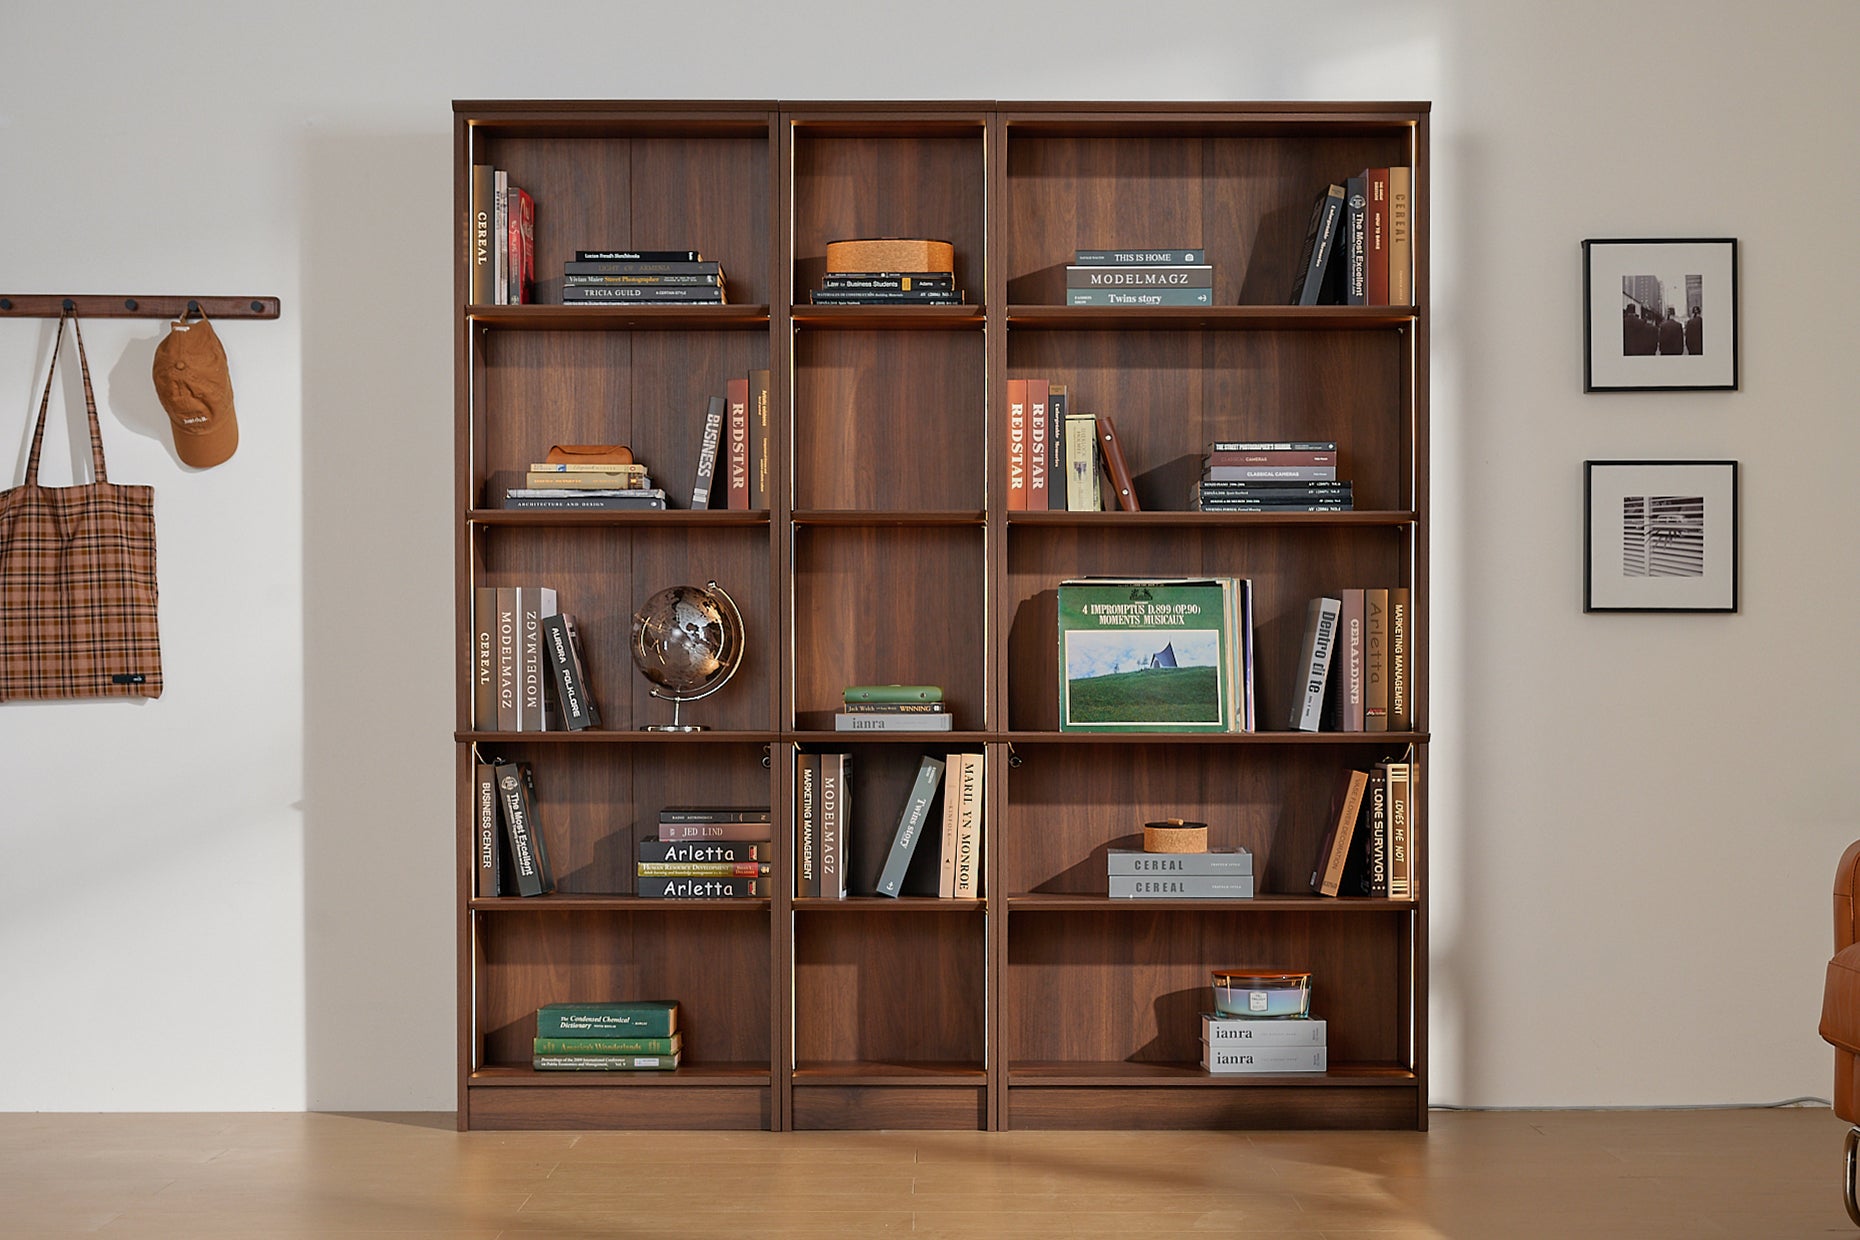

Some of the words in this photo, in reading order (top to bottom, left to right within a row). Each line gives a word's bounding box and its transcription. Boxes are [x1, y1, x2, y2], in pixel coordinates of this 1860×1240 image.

[1355, 212, 1364, 230] The
[1395, 193, 1406, 244] CEREAL
[477, 211, 488, 266] CEREAL
[1355, 231, 1364, 254] Most
[1114, 253, 1134, 262] THIS
[1135, 253, 1144, 262] IS
[1145, 253, 1171, 262] HOME
[622, 276, 660, 284] Photographer
[827, 280, 840, 288] Law
[846, 280, 872, 288] Business
[873, 280, 899, 288] Students
[1090, 273, 1189, 285] MODELMAGZ
[1355, 255, 1364, 297] Excellent
[584, 289, 612, 297] TRICIA
[615, 289, 641, 297] GUILD
[1108, 293, 1137, 304] Twins
[1138, 294, 1162, 304] story
[697, 412, 721, 477] BUSINESS
[731, 402, 745, 489] REDSTAR
[1011, 403, 1023, 489] REDSTAR
[1032, 403, 1045, 489] REDSTAR
[1082, 604, 1088, 615] 4
[1091, 604, 1145, 615] IMPROMPTUS
[1172, 604, 1201, 615] (OP.90)
[1099, 615, 1141, 625] MOMENTS
[1143, 615, 1185, 625] MUSICAUX
[1314, 610, 1336, 659] Dentro
[1394, 604, 1403, 654] MARKETING
[1369, 602, 1383, 684] Arletta
[480, 632, 490, 685] CEREAL
[501, 611, 512, 709] MODELMAGZ
[526, 611, 537, 709] MODELMAGZ
[1311, 663, 1326, 676] di
[551, 627, 567, 664] AURORA
[562, 668, 581, 718] FOLKLORE
[1394, 654, 1403, 715] MANAGEMENT
[1308, 680, 1323, 693] te
[852, 717, 885, 729] ianra
[482, 782, 491, 829] BUSINESS
[511, 792, 520, 810] The
[803, 769, 812, 819] MARKETING
[1374, 788, 1384, 819] LONE
[514, 811, 525, 834] Most
[909, 797, 927, 825] Twins
[1343, 797, 1356, 827] FLOWER
[1394, 799, 1404, 825] LOVES
[682, 827, 698, 837] JED
[702, 827, 723, 836] LIND
[823, 777, 835, 874] MODELMAGZ
[899, 824, 914, 849] story
[1395, 828, 1404, 842] ME
[482, 831, 492, 868] CENTER
[518, 834, 533, 876] Excellent
[664, 845, 735, 861] Arletta
[803, 819, 812, 880] MANAGEMENT
[959, 833, 971, 890] MONROE
[1331, 827, 1349, 870] DECORATION
[1374, 821, 1384, 882] SURVIVOR
[1395, 845, 1404, 863] NOT
[1134, 860, 1184, 871] CEREAL
[663, 880, 734, 896] Arletta
[1135, 882, 1185, 893] CEREAL
[560, 1022, 592, 1030] Dictionary
[570, 1015, 602, 1023] Condensed
[1216, 1026, 1253, 1039] ianra
[1217, 1051, 1254, 1064] ianra
